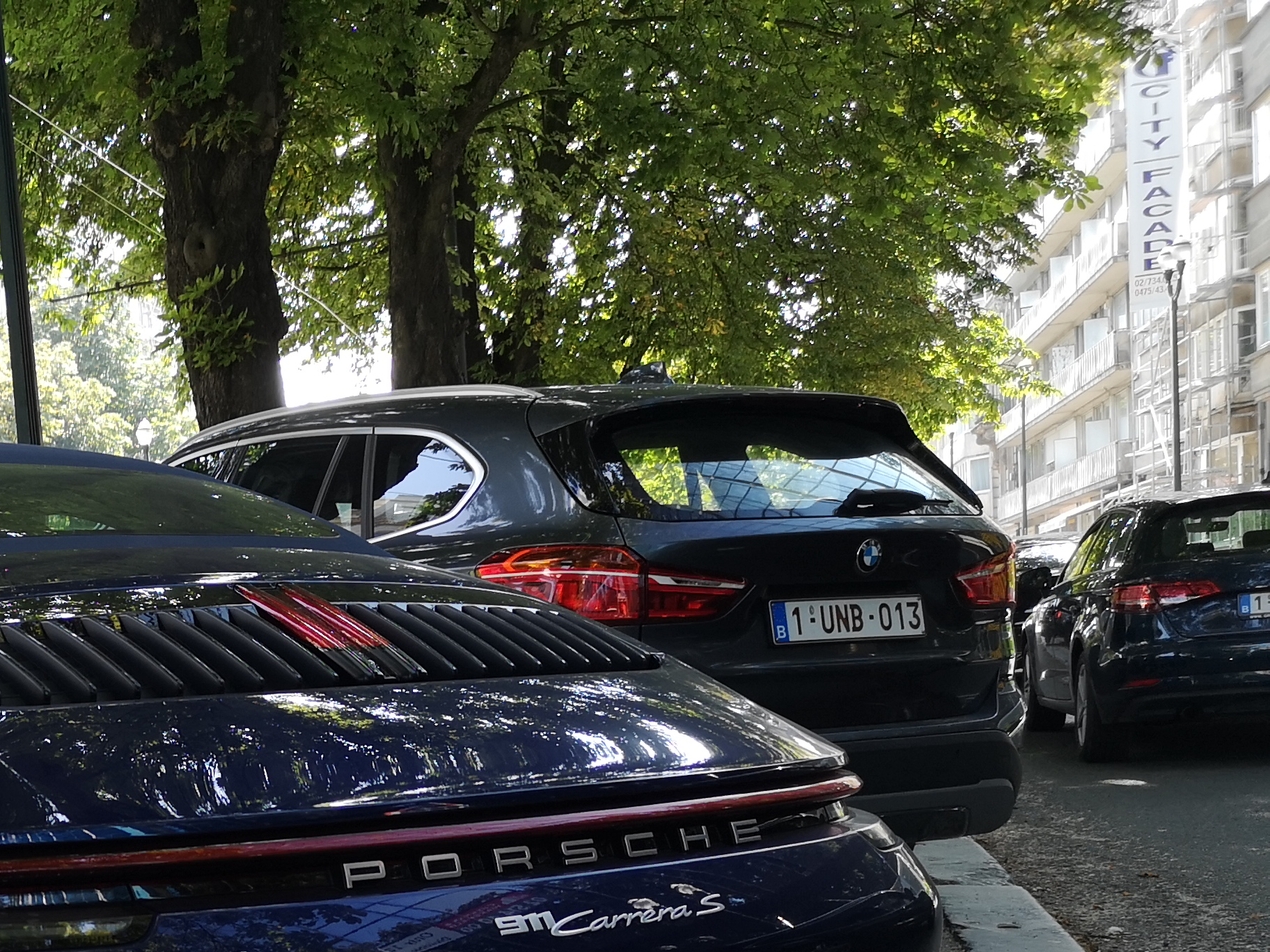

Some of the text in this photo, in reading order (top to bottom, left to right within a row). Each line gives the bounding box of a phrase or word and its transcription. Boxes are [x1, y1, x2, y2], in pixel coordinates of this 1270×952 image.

[1140, 84, 1172, 151] CITY
[1241, 605, 1250, 613] B
[776, 625, 787, 639] B
[342, 818, 762, 889] PORSCHE
[494, 909, 555, 936] 911
[549, 904, 693, 938] Carrera
[695, 893, 727, 916] S
